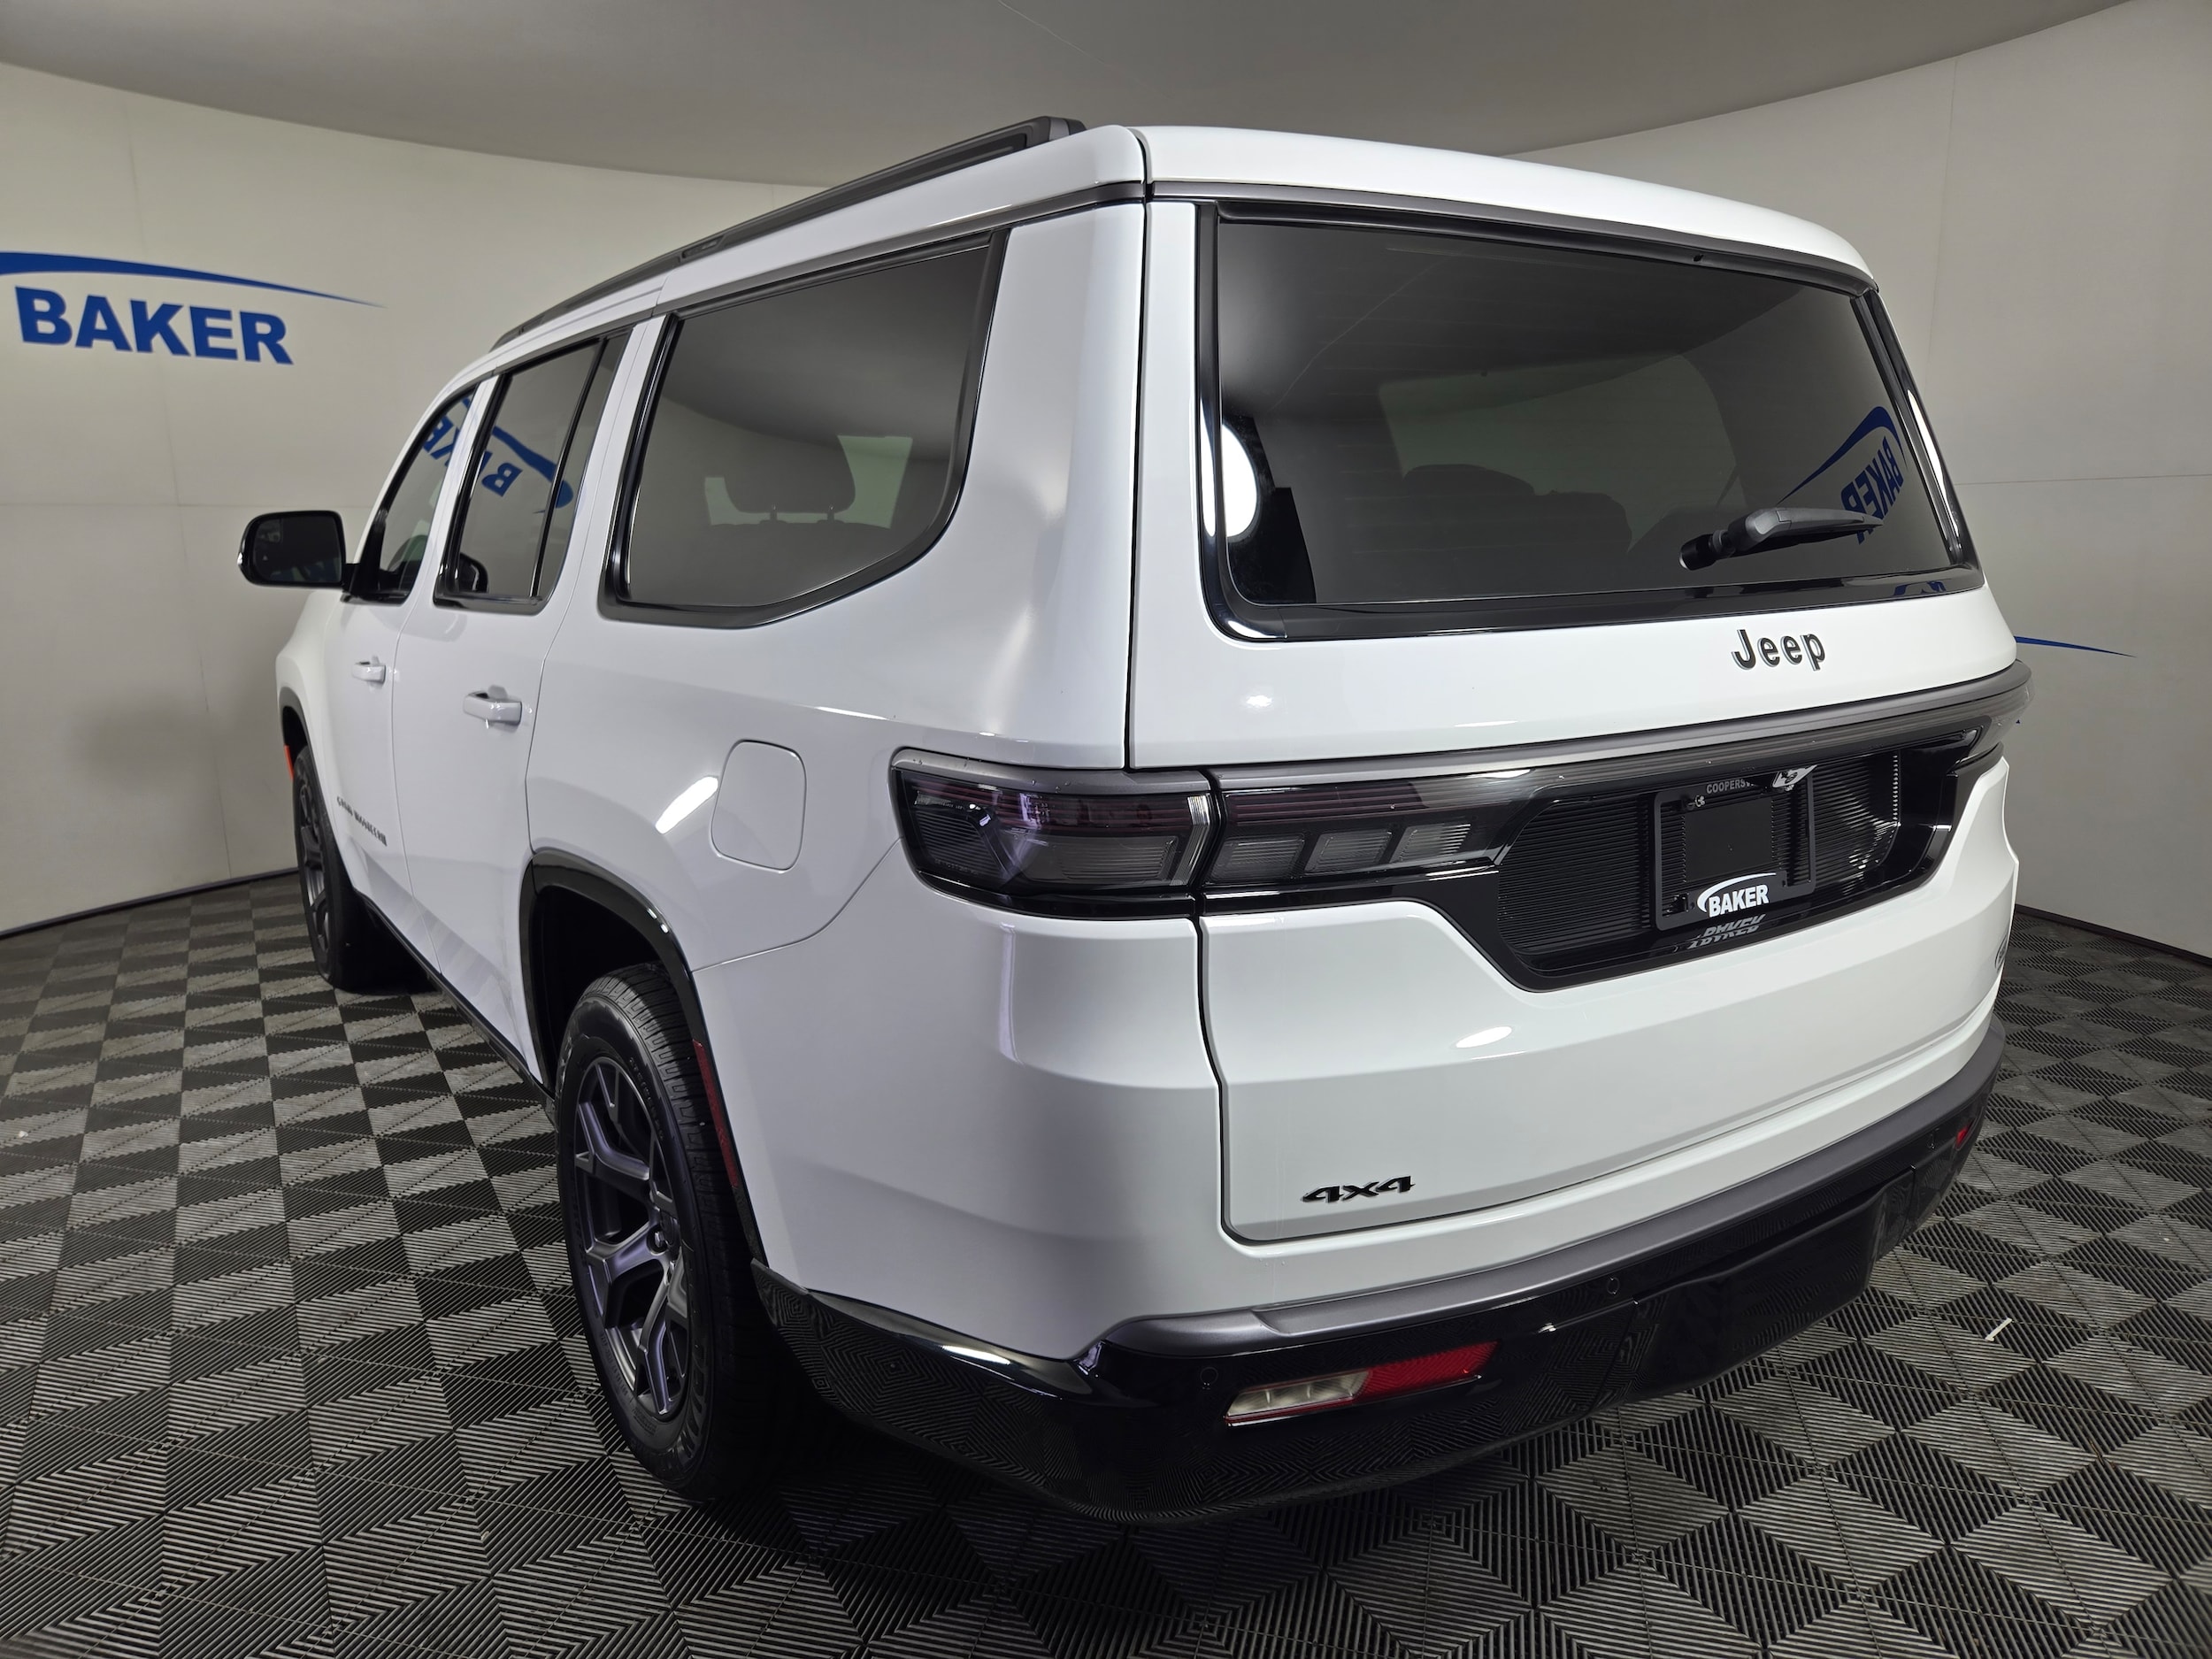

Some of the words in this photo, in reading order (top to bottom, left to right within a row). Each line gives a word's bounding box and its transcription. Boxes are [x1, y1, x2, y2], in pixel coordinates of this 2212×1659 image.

[15, 286, 294, 365] BAKER
[1732, 629, 1825, 671] Jeep
[1709, 885, 1769, 918] BAKER
